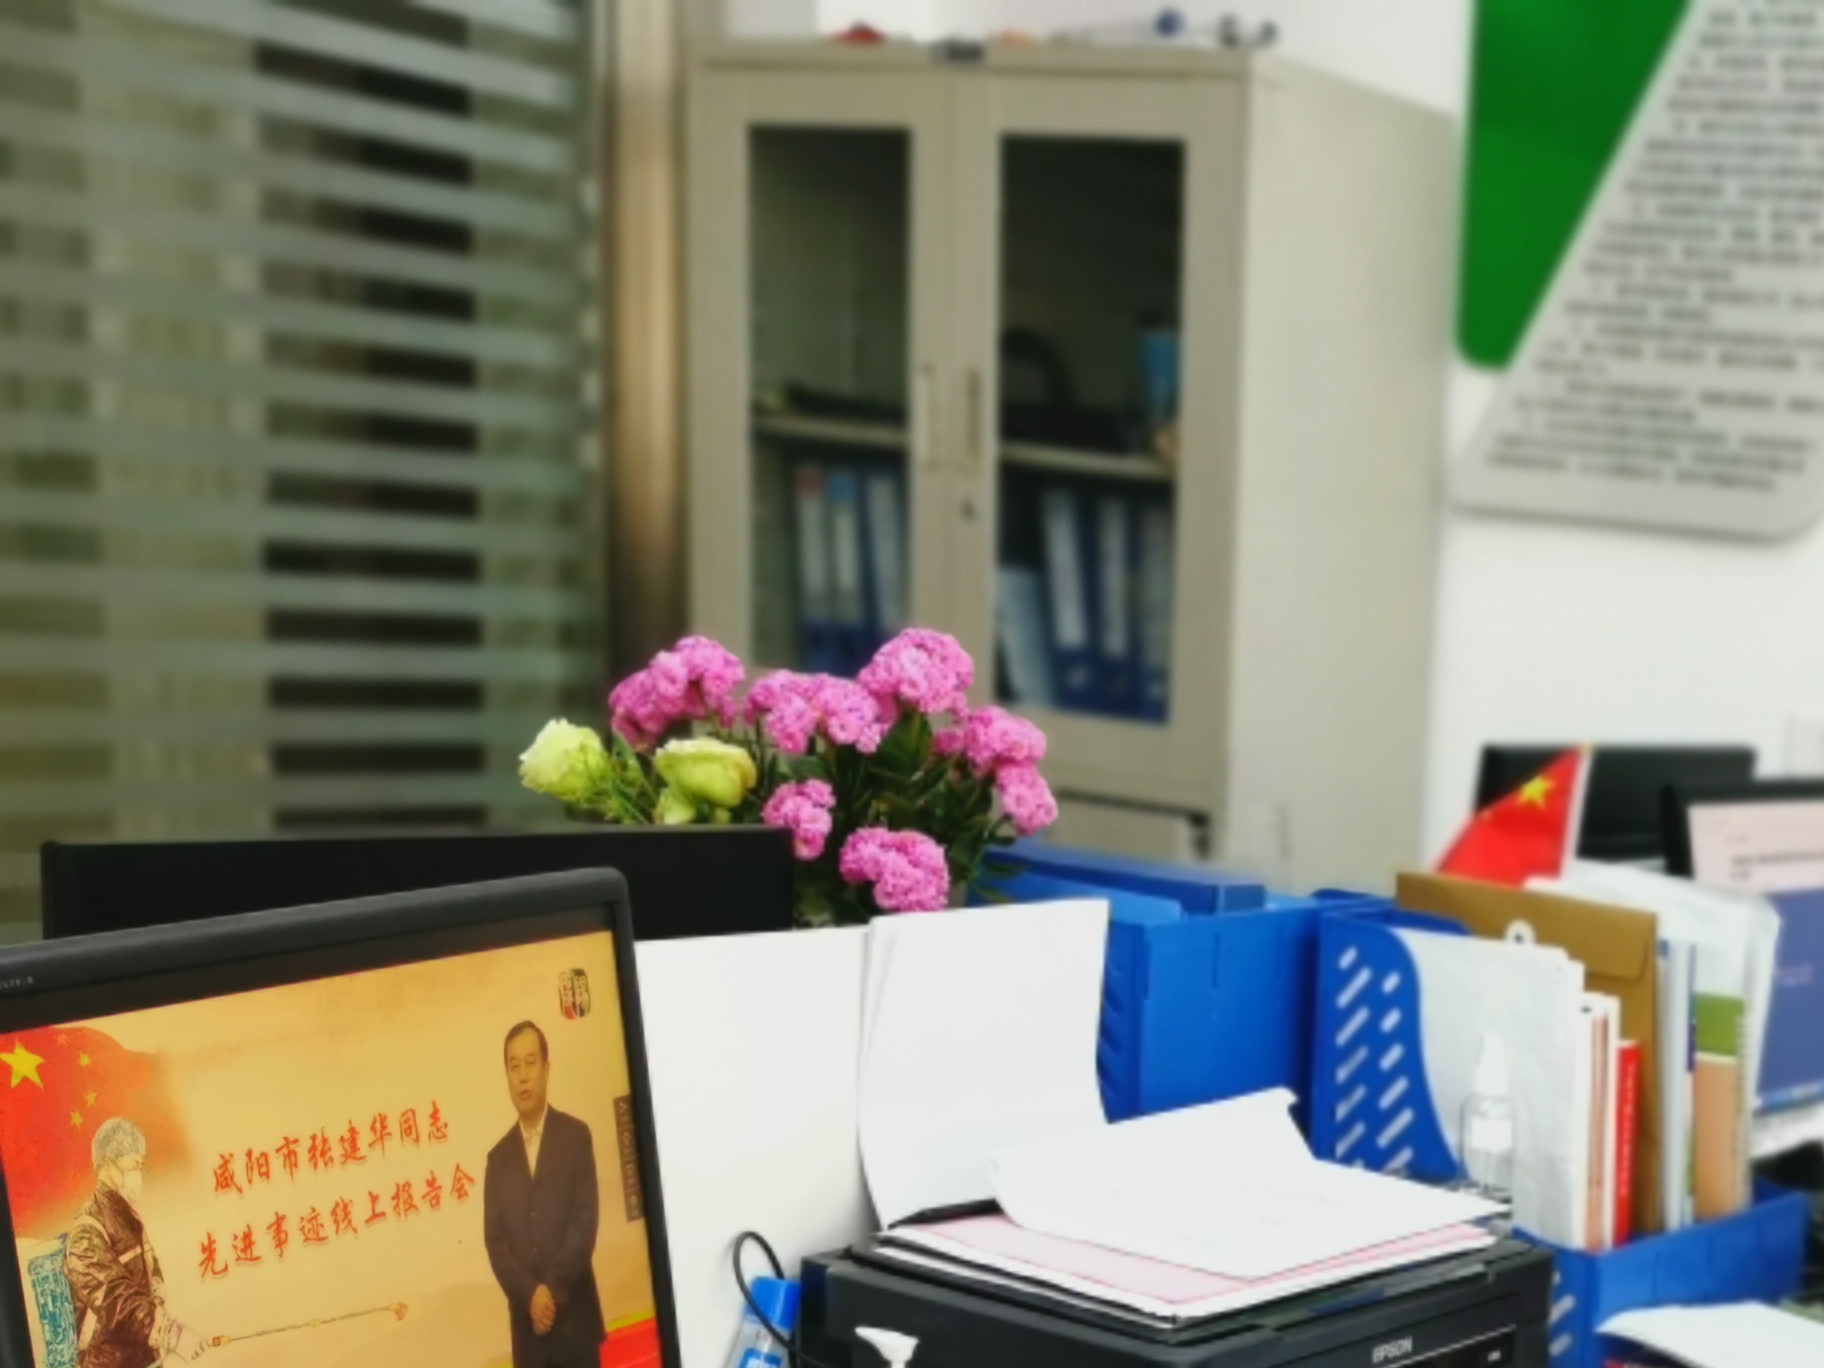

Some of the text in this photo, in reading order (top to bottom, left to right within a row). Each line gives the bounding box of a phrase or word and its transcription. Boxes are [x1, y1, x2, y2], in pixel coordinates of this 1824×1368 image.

[212, 1100, 449, 1196] 咸阳市张建华同志
[198, 1162, 475, 1279] 先进事迹线上报告会
[1372, 1336, 1413, 1364] EPSON
